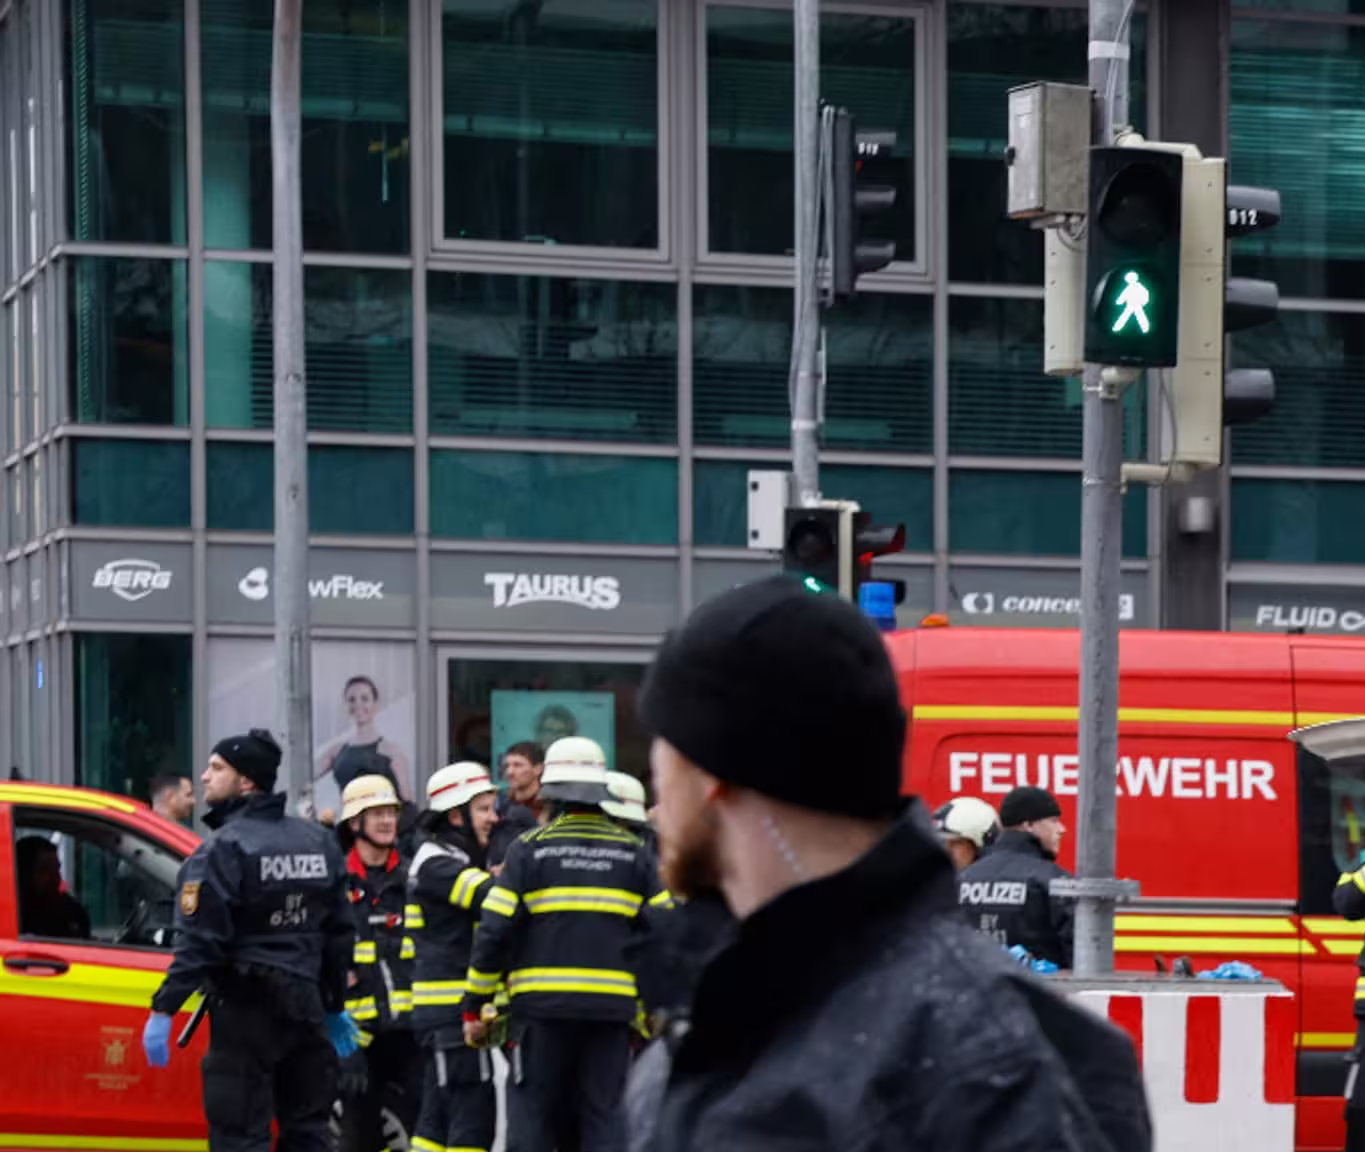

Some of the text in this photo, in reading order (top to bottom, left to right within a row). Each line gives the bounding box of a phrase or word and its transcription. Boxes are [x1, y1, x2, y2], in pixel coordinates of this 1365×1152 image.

[92, 569, 173, 591] BERG
[484, 572, 621, 610] TAURUS
[1256, 605, 1337, 628] FLUID
[949, 751, 1277, 800] FEUEWEHR
[260, 853, 328, 881] POLIZEI
[959, 882, 1027, 905] POLIZEI
